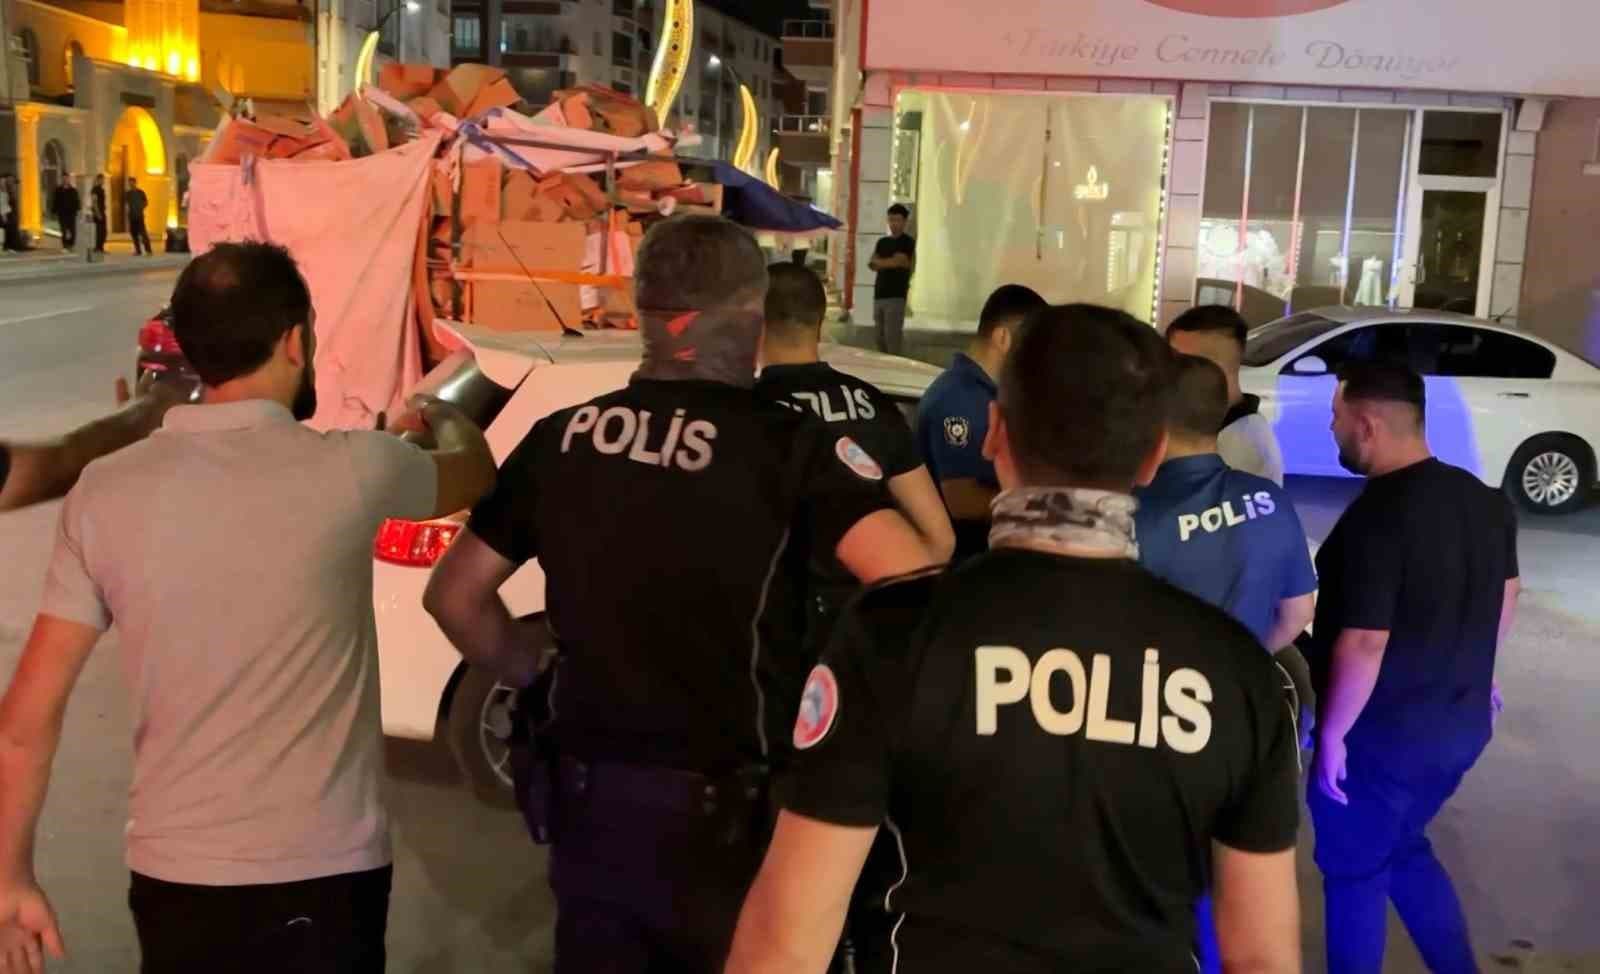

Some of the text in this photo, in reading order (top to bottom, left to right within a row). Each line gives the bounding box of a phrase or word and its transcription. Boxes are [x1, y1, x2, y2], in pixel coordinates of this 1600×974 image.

[560, 405, 718, 472] POLİS
[1177, 491, 1276, 541] POLİS
[975, 646, 1213, 754] POLİS
